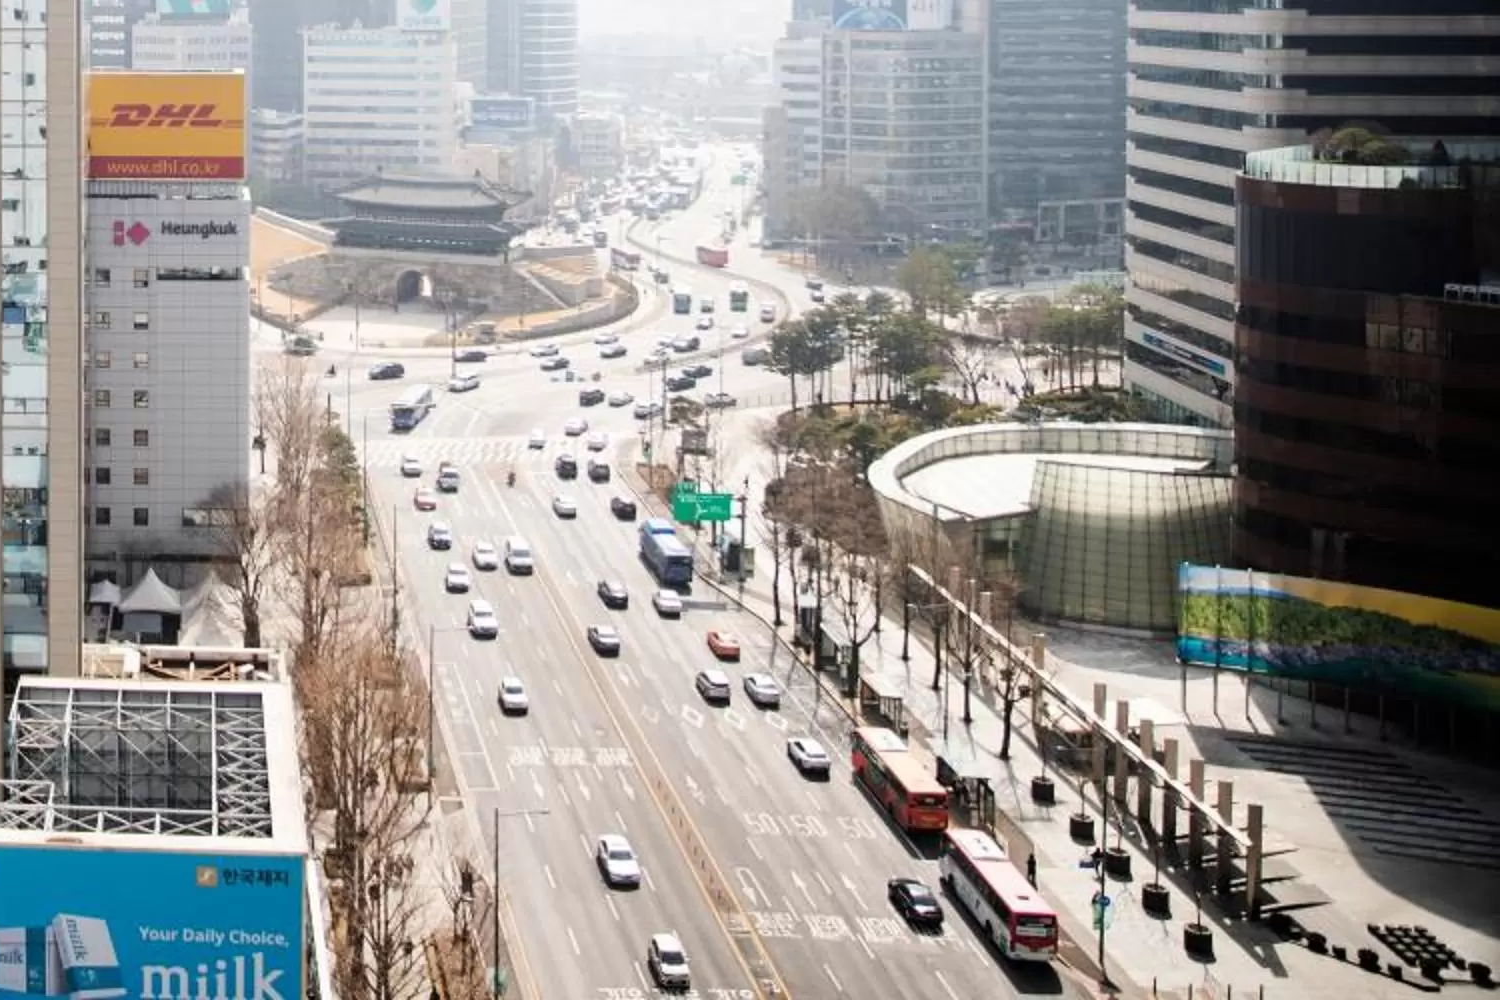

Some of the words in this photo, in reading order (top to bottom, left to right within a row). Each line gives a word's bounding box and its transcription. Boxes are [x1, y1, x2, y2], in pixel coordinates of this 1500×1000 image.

[109, 103, 222, 127] DHL
[107, 159, 220, 175] www.dhl.co.kr
[160, 220, 238, 239] Heungkuk
[222, 868, 289, 888] 한국제지
[139, 926, 178, 942] Your
[183, 927, 225, 947] Daily
[229, 930, 290, 948] Choice,
[140, 951, 286, 1000] miilk
